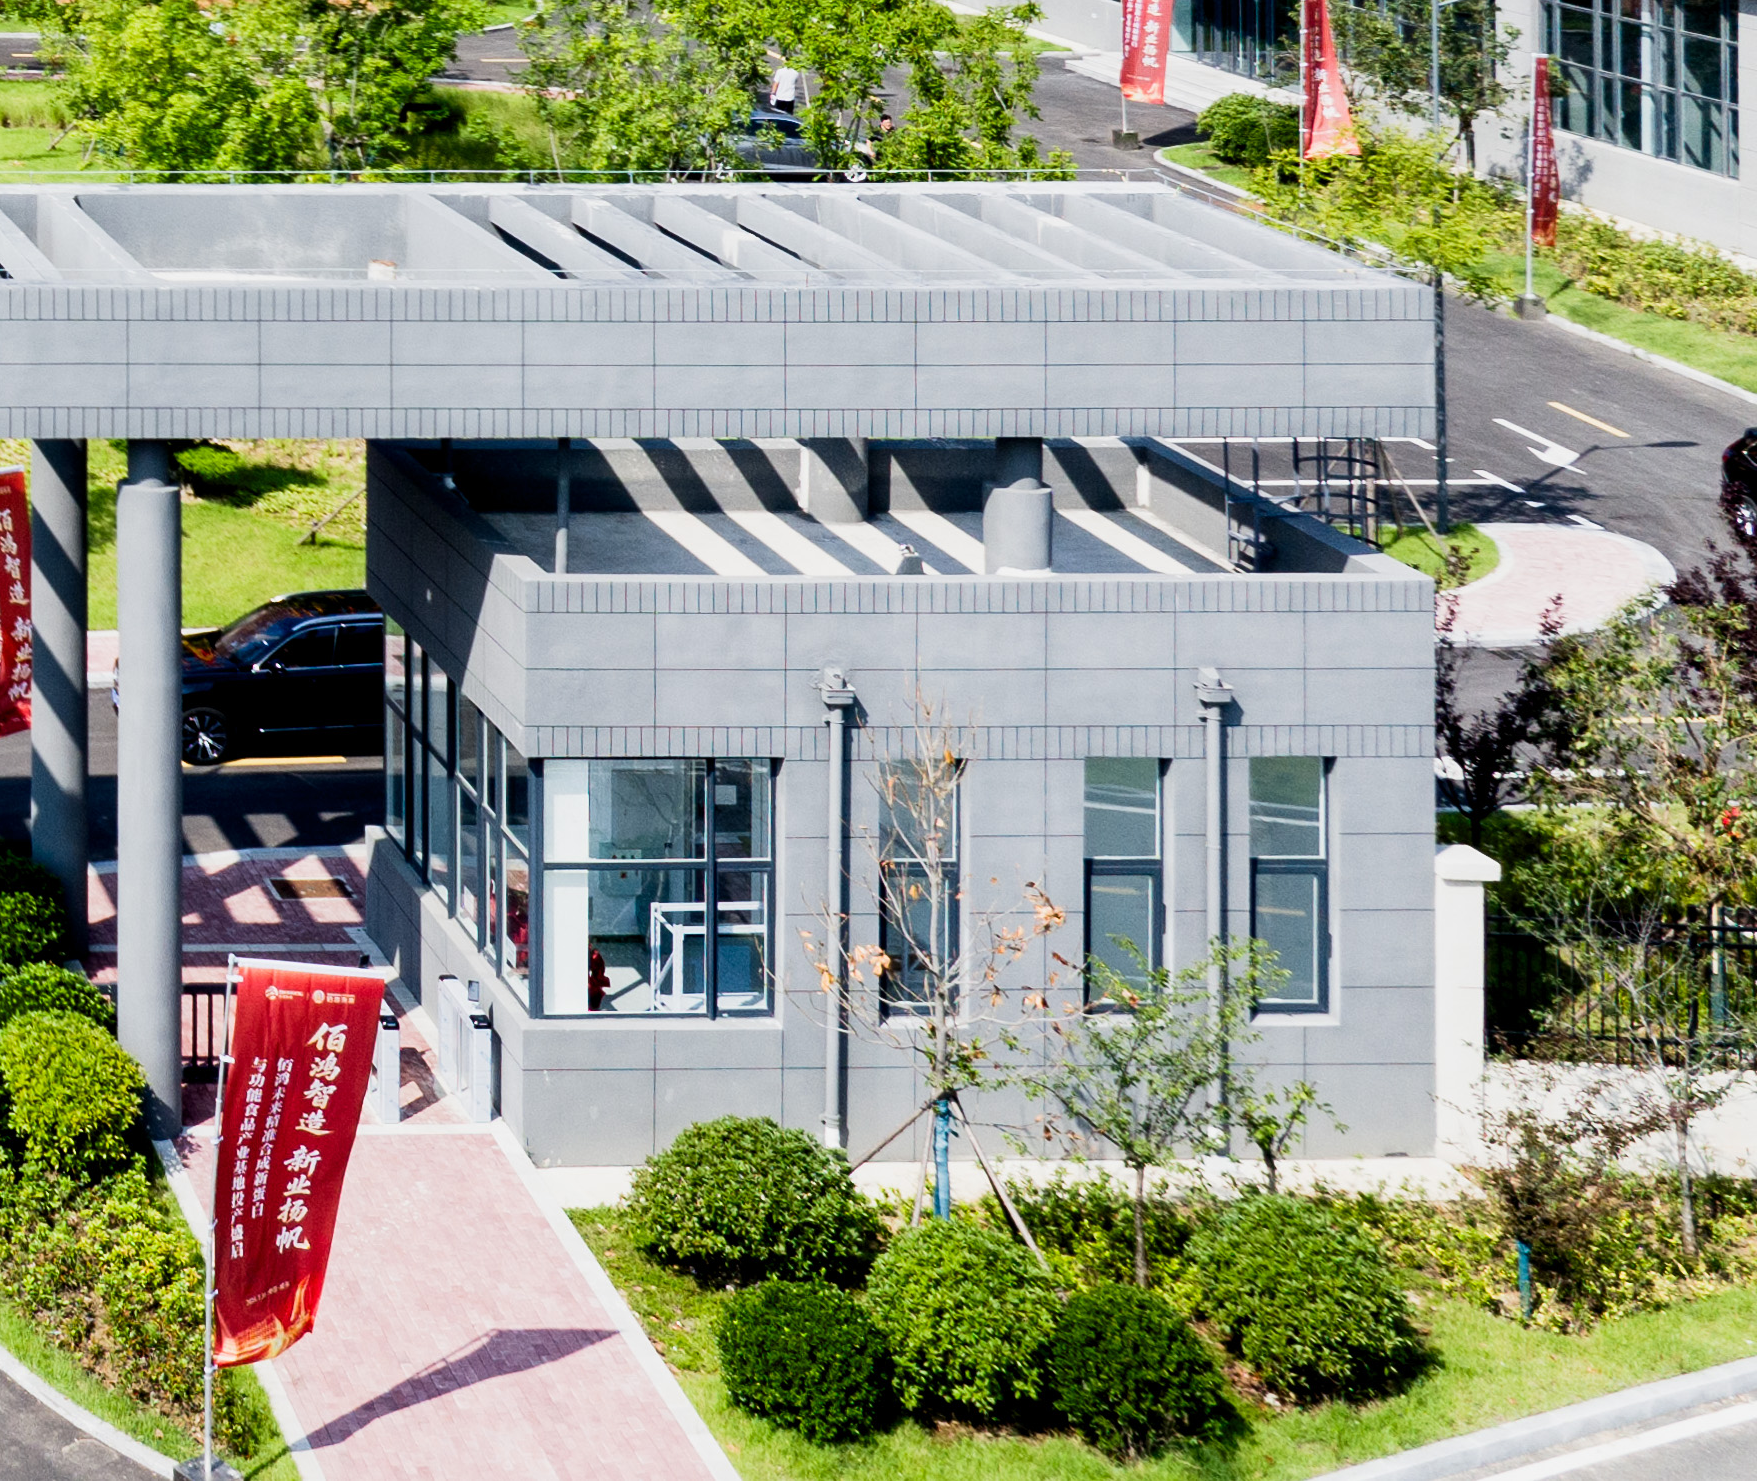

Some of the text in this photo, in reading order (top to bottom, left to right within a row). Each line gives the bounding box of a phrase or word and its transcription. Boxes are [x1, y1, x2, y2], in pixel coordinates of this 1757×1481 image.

[294, 1021, 349, 1137] 佰鸿智造
[275, 1144, 323, 1255] 新业扬帆
